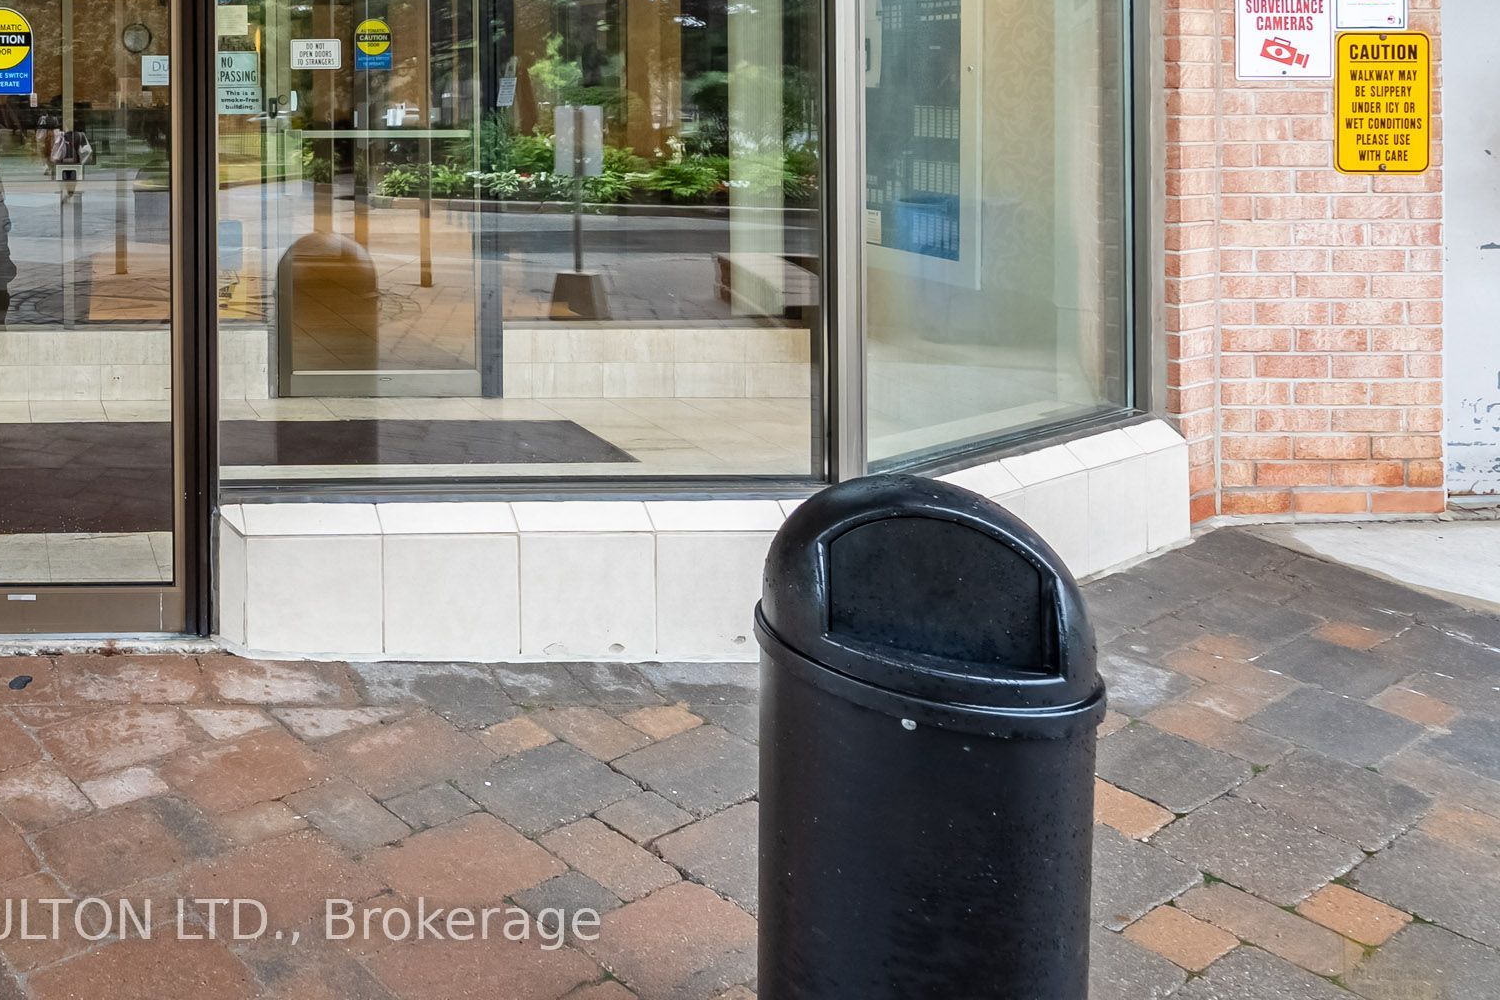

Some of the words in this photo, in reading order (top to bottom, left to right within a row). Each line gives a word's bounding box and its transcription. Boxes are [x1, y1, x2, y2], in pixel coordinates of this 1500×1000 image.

[1256, 15, 1314, 31] CAMERAS
[1349, 44, 1418, 60] CAUTION
[221, 56, 233, 68] NO
[305, 58, 335, 66] STRANGERS
[1350, 70, 1394, 81] WALKWAY
[1398, 70, 1418, 81] MAY
[1355, 85, 1366, 97] BE
[1370, 85, 1412, 97] SLIPPERY
[1352, 102, 1381, 113] UNDER
[1385, 102, 1400, 113] ICY
[1404, 102, 1415, 113] OR
[1345, 118, 1364, 129] WET
[1368, 118, 1422, 129] CONDITIONS
[1356, 134, 1389, 145] PLEASE
[1394, 134, 1411, 145] USE
[1359, 150, 1381, 161] WITH
[1385, 150, 1408, 161] CARE
